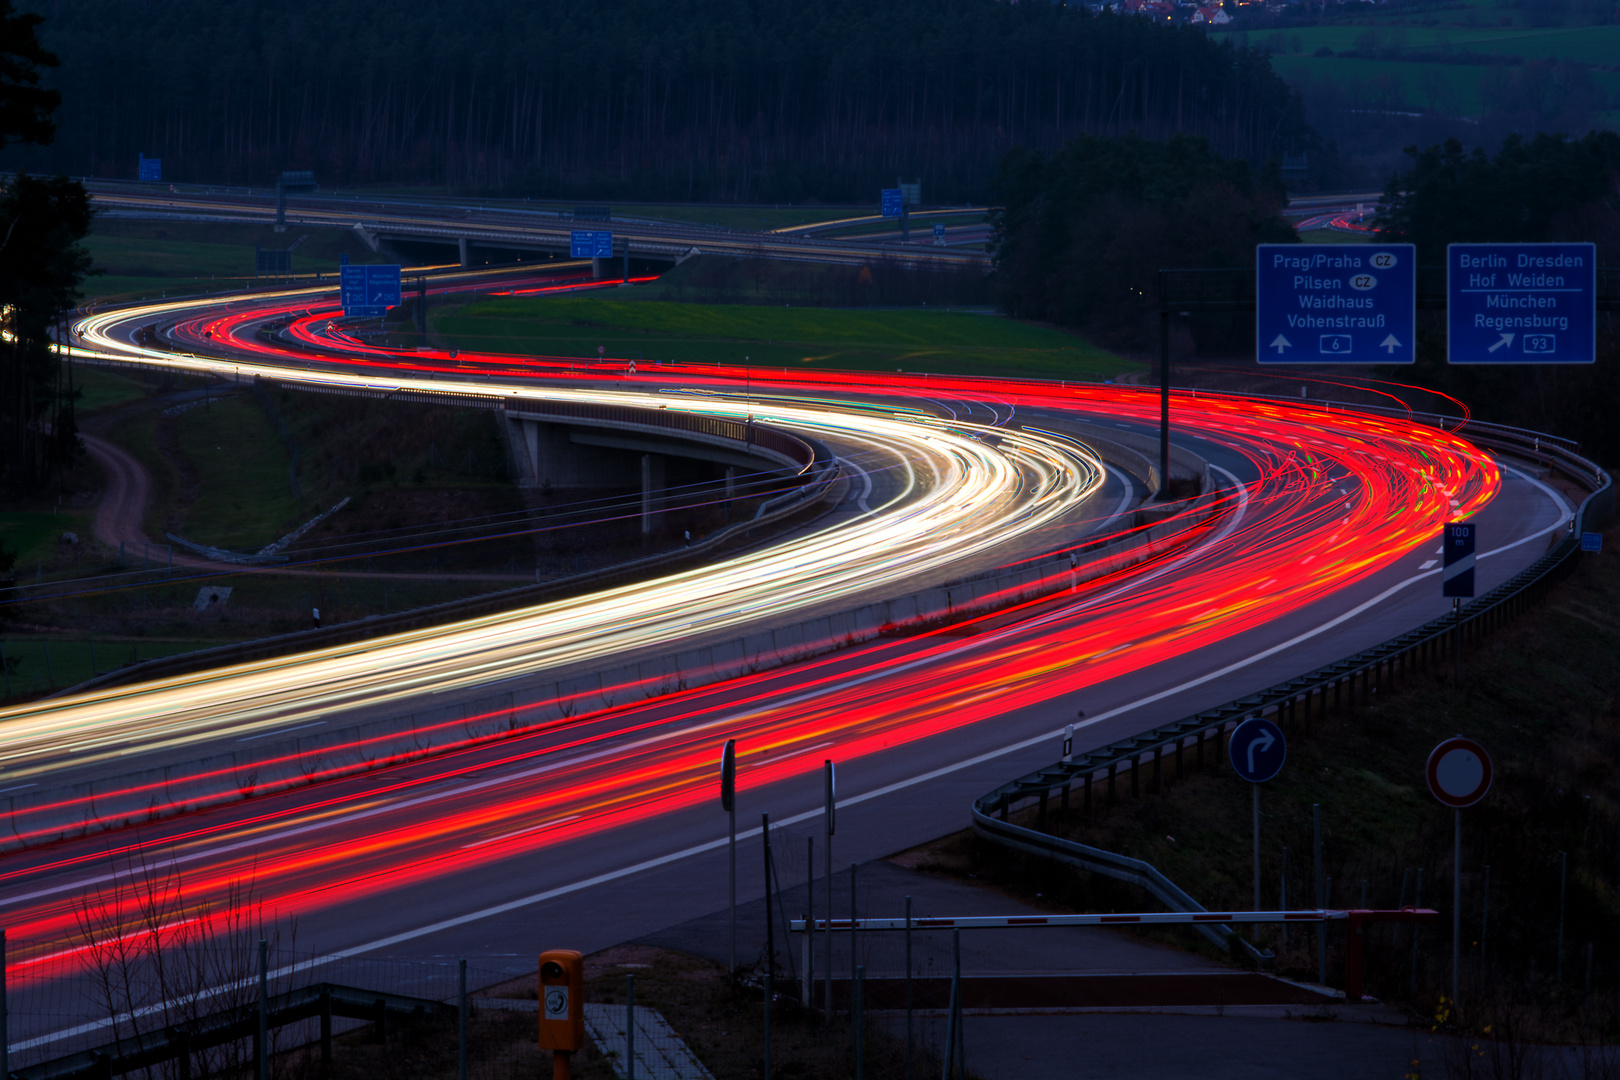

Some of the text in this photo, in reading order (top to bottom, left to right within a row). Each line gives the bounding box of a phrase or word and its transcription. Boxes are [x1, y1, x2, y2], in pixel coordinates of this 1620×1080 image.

[1274, 254, 1391, 271] Prag/Praha CZ
[1461, 254, 1583, 267] Berlin Dresden
[1294, 276, 1371, 289] Pilsen CZ
[1470, 273, 1564, 287] Hof Weiden
[1299, 295, 1373, 308] Waidhaus
[1487, 294, 1556, 308] München
[1287, 314, 1385, 328] Vohenstrauß
[1475, 314, 1568, 330] Regensburg
[1332, 338, 1339, 350] 6
[1532, 338, 1547, 350] 93
[1451, 527, 1469, 537] 100
